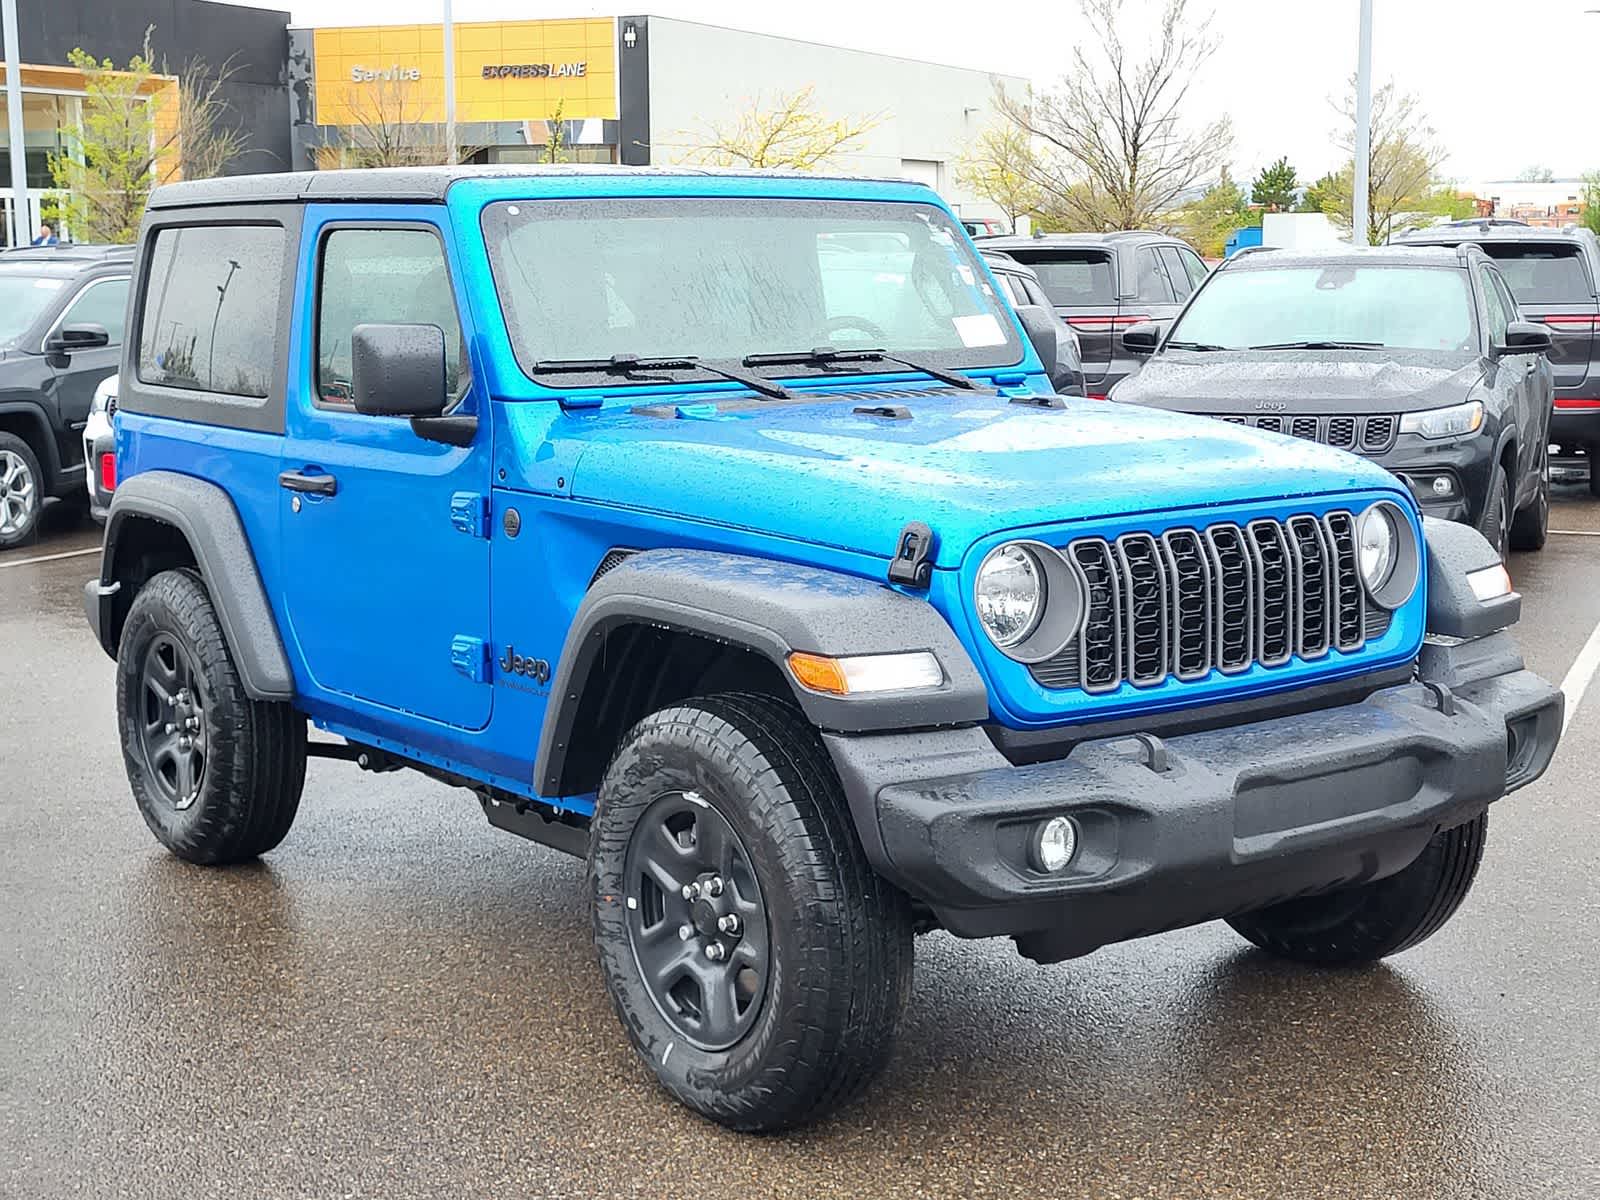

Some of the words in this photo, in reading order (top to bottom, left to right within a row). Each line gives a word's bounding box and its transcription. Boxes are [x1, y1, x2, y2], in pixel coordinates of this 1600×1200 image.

[352, 64, 421, 82] Service
[1255, 400, 1287, 411] Jeep
[499, 645, 551, 687] Jeep
